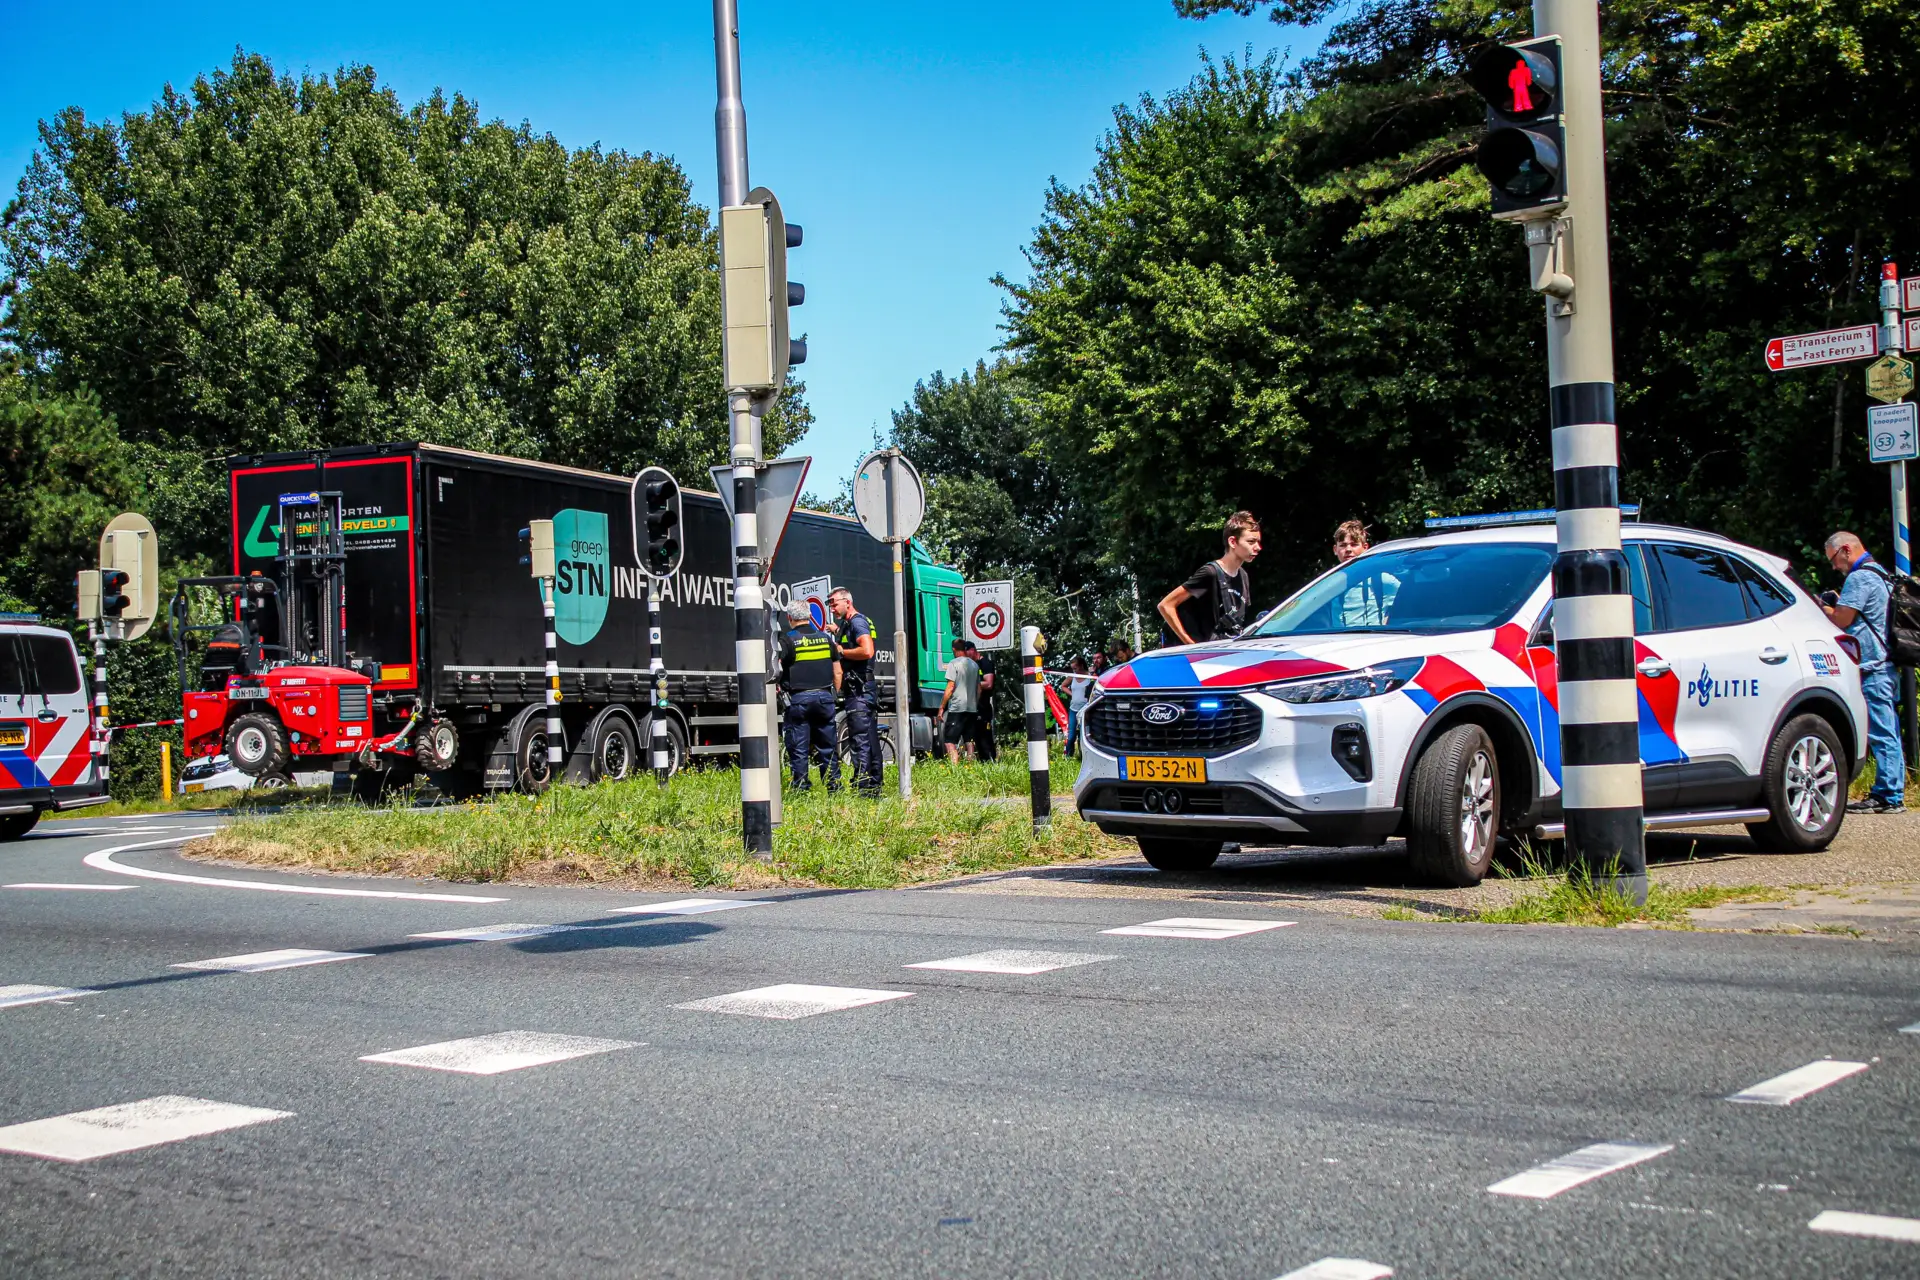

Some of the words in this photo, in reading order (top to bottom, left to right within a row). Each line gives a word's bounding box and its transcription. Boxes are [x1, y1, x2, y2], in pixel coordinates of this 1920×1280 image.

[1910, 282, 1920, 290] H
[1911, 322, 1920, 331] G
[1797, 332, 1862, 348] Transferium
[1803, 350, 1825, 360] Fast
[1829, 346, 1857, 356] Ferry
[1873, 416, 1910, 425] knooppunt
[1878, 437, 1892, 447] 53
[571, 540, 603, 559] groep
[552, 559, 604, 597] STN
[682, 573, 735, 608] WATE
[802, 584, 819, 595] ZONE
[975, 587, 1000, 595] ZONE
[976, 612, 1000, 628] 60
[1823, 654, 1838, 667] 112
[1148, 706, 1172, 720] Ford
[1131, 760, 1197, 778] JTS-52-N
